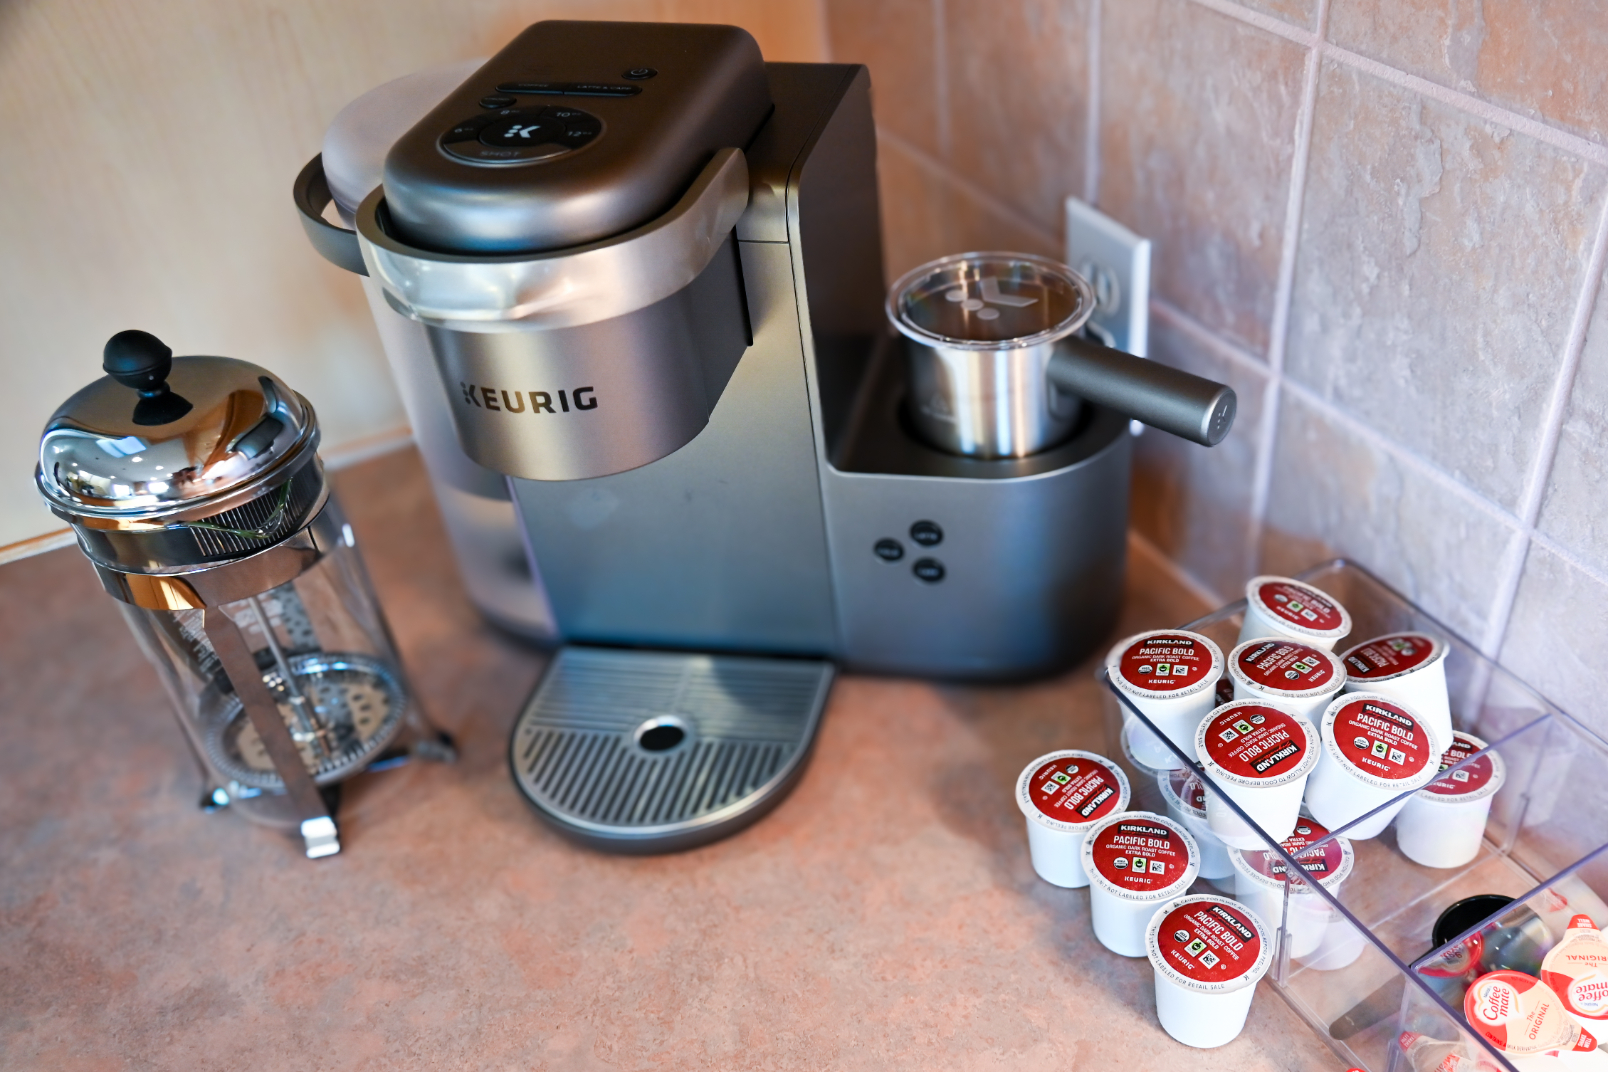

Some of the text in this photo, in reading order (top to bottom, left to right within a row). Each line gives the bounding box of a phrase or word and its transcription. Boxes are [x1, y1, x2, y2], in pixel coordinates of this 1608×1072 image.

[460, 381, 598, 414] KEURIG
[1257, 653, 1281, 669] PACIFIC
[1219, 712, 1242, 725] KEURIG
[1357, 713, 1414, 740] PACIFIC BOLD
[1366, 705, 1412, 725] KIRKLAND
[1228, 723, 1286, 757] ORGANIC DARK ROAST COFFEE
[1251, 727, 1266, 736] EXTRA
[1349, 720, 1418, 750] ORGANIC DARK ROAST COFFEE
[1367, 731, 1398, 746] EXTRA BOLD
[1239, 730, 1289, 761] PACIFIC BOLD
[1257, 745, 1297, 771] KIRKLAND
[1362, 757, 1390, 771] KEURIG
[1060, 776, 1104, 809] PACIFIC BOLD
[1082, 788, 1113, 816] KIRKLAND
[1121, 825, 1167, 835] KIRKLAND
[1114, 836, 1170, 849] PACIFIC BOLD
[1124, 876, 1152, 884] KEURIG
[1194, 911, 1243, 951] PACIFIC BOLD
[1213, 907, 1251, 937] KIRKLAND
[1184, 914, 1239, 960] ORGANIC DARK ROAST COFFEE
[1194, 928, 1220, 949] EXTRA BOLD
[1171, 950, 1194, 969] KEURIG
[1175, 976, 1187, 984] FOR
[1188, 981, 1208, 990] RETAIL
[1576, 982, 1608, 993] mate
[1483, 986, 1501, 1020] Coffee
[1499, 988, 1509, 1017] mate
[1526, 1011, 1536, 1021] The
[1528, 1003, 1550, 1040] ORIGINAL
